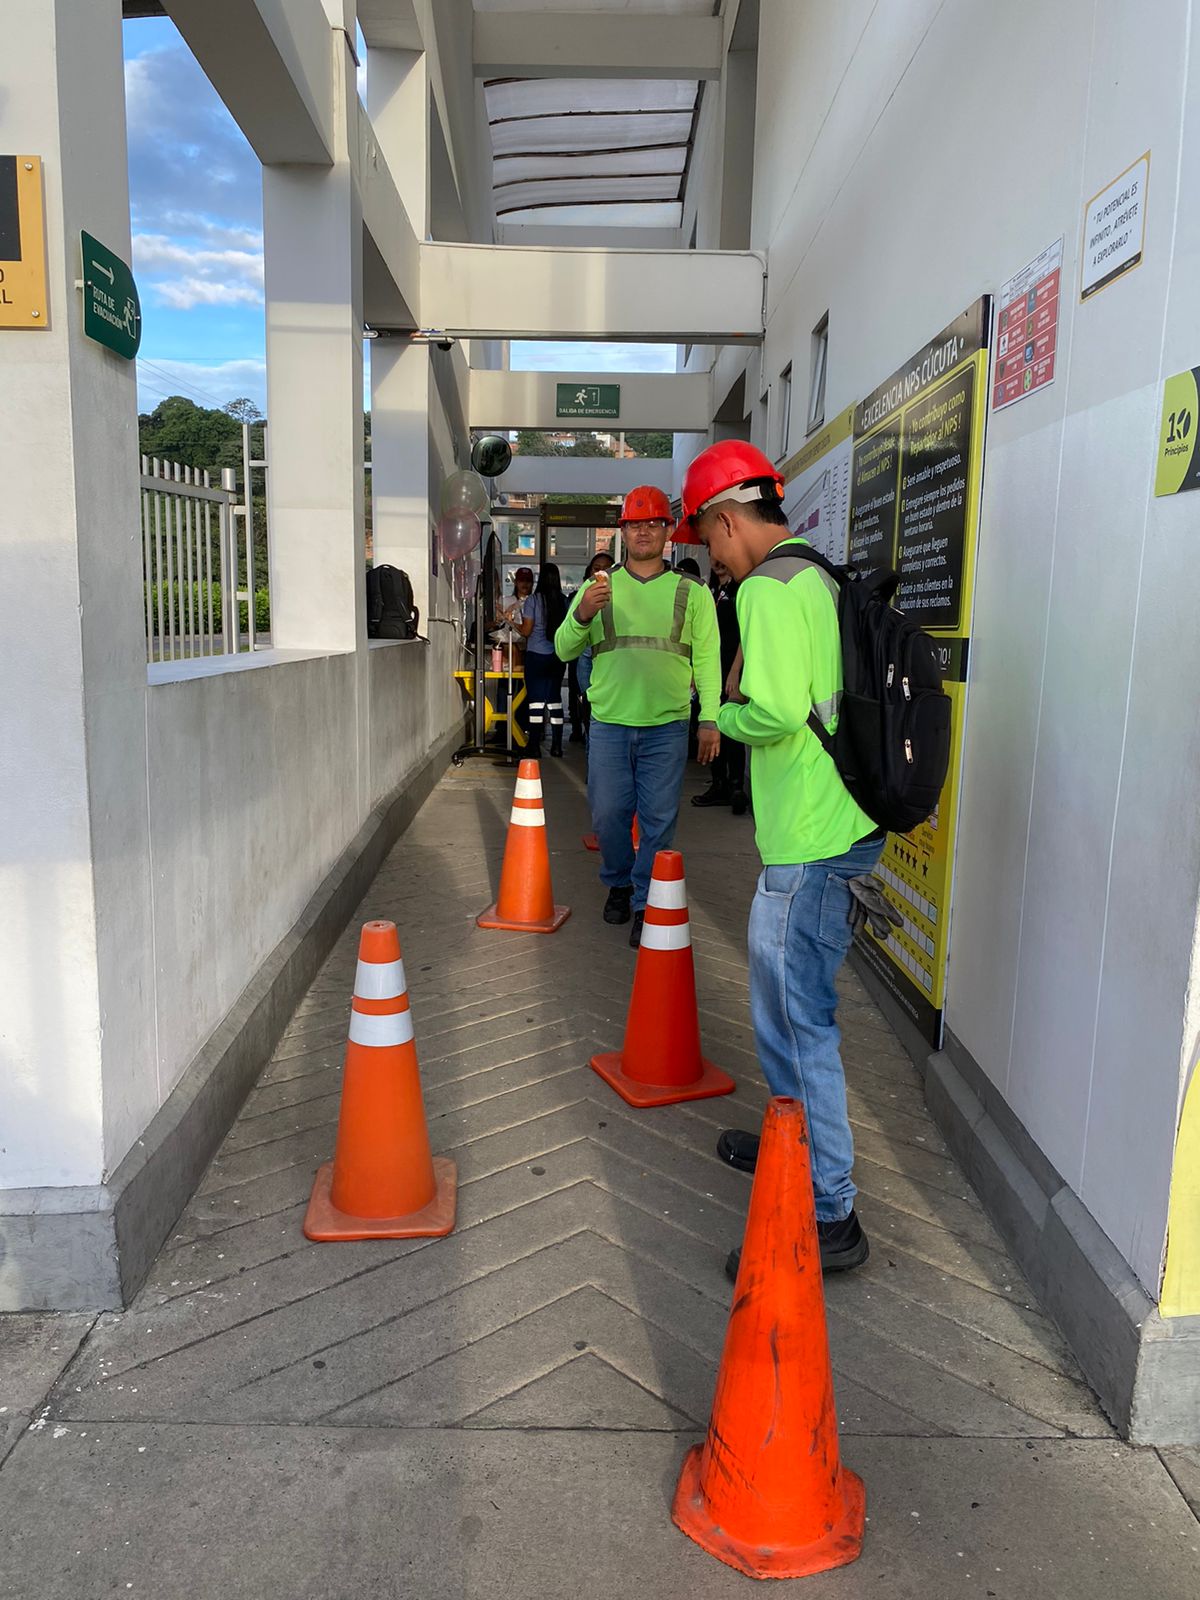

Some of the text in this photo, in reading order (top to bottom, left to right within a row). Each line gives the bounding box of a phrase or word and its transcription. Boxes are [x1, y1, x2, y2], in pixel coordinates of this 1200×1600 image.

[1103, 188, 1131, 219] POTENCIAL
[1131, 181, 1138, 197] ES
[93, 285, 115, 311] RUTA DE
[93, 302, 123, 331] EVACUACIÓN
[864, 335, 958, 430] EXCELENCIA NPS CÚCUTA
[948, 390, 966, 412] como
[937, 422, 944, 441] al
[1166, 407, 1191, 443] 10
[1164, 443, 1189, 456] Principios
[916, 465, 930, 483] amable
[946, 476, 966, 497] pedidos
[916, 580, 924, 592] mis
[924, 578, 941, 592] clientes
[941, 579, 948, 590] en
[948, 575, 953, 589] la
[921, 598, 929, 608] sus
